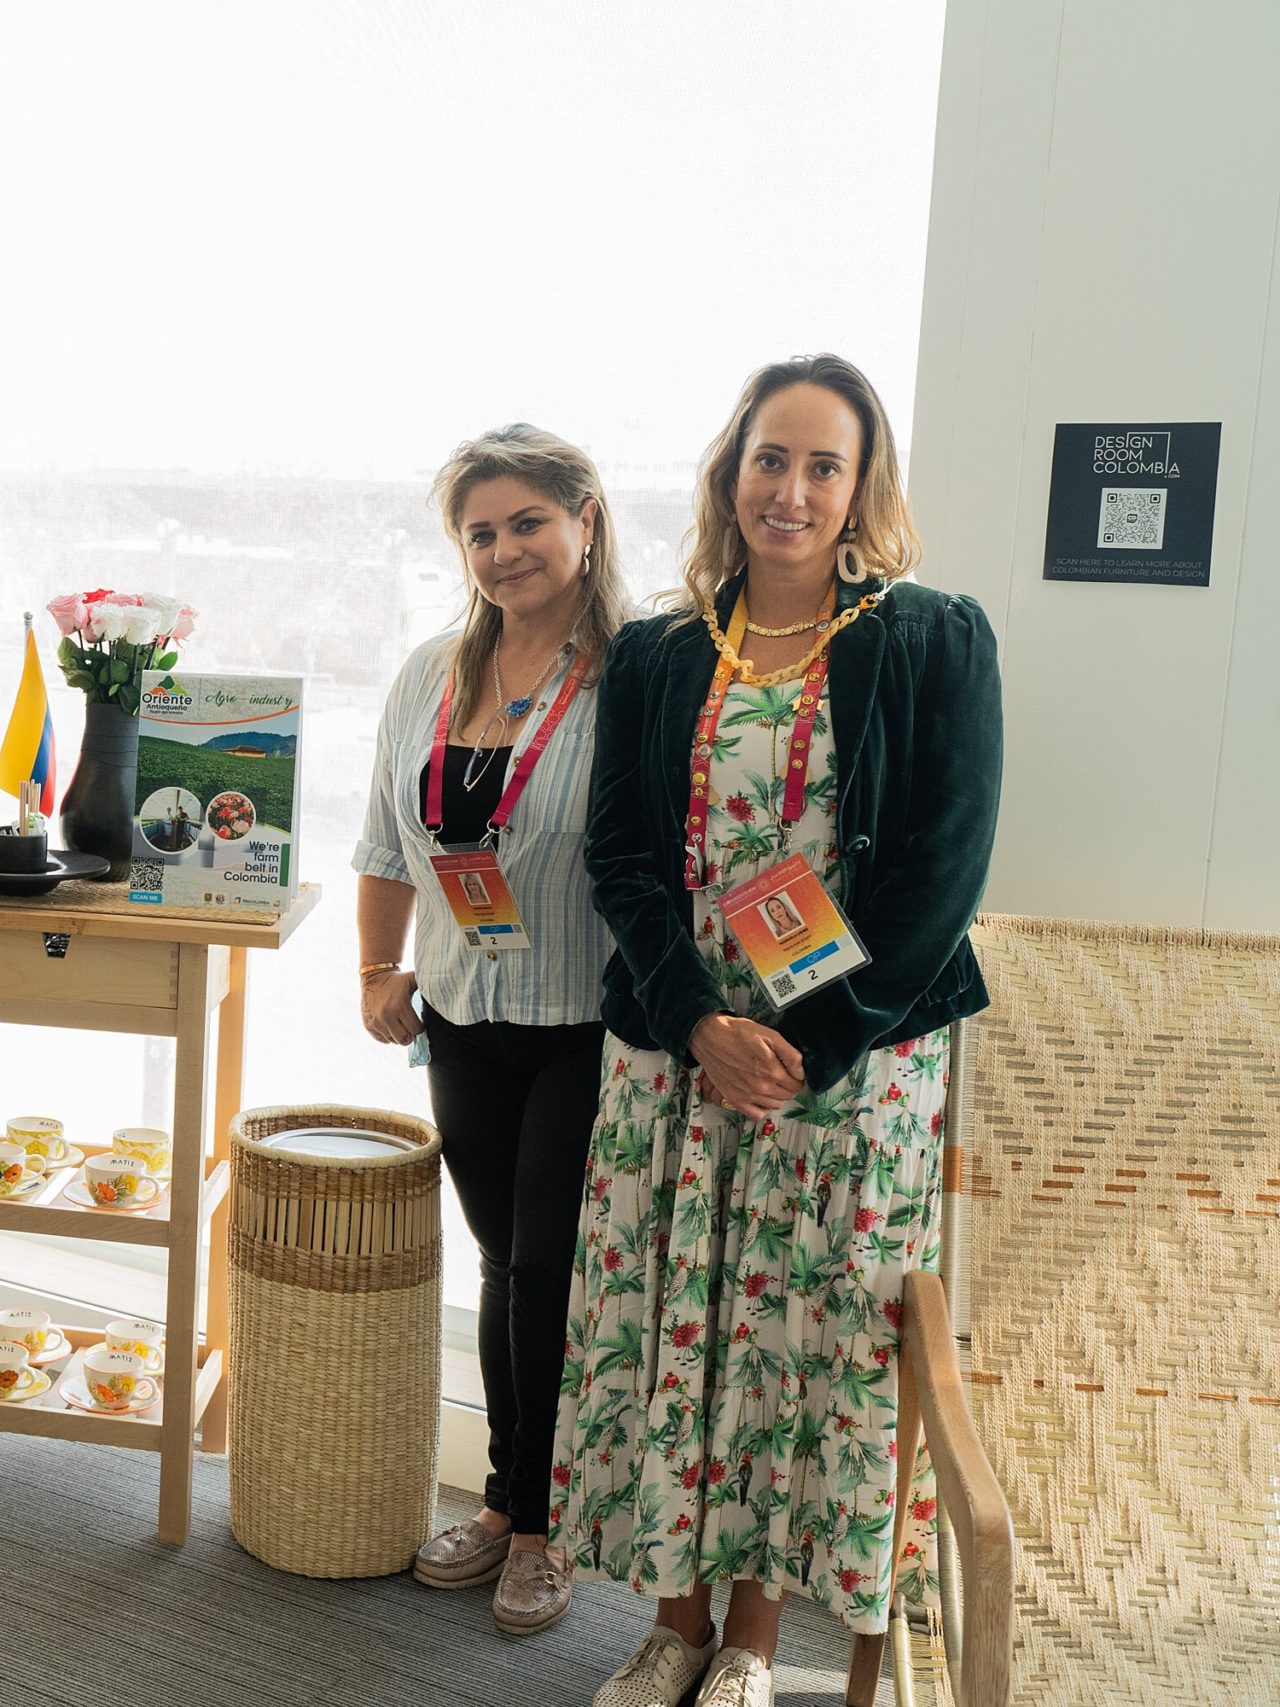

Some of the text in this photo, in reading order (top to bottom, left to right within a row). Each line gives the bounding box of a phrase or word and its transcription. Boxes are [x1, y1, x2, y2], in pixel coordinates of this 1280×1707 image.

[1094, 436, 1153, 449] DESIGN
[1093, 449, 1143, 461] ROOM
[1092, 462, 1180, 474] COLOMBIA
[1145, 560, 1171, 568] MORE
[1172, 561, 1202, 569] ABOUT
[1052, 566, 1102, 575] COLOMBIAN
[1103, 568, 1151, 576] FURNITURE
[1172, 570, 1205, 578] DESIGN
[142, 692, 193, 705] Oriente
[205, 690, 237, 707] Agro
[249, 840, 280, 852] We're
[254, 852, 279, 862] farm
[244, 862, 278, 873] belt in
[223, 871, 278, 884] Colombia
[490, 936, 498, 945] 2
[808, 969, 819, 981] 2
[110, 1158, 135, 1167] MATIZ
[108, 1354, 133, 1363] MATIZ
